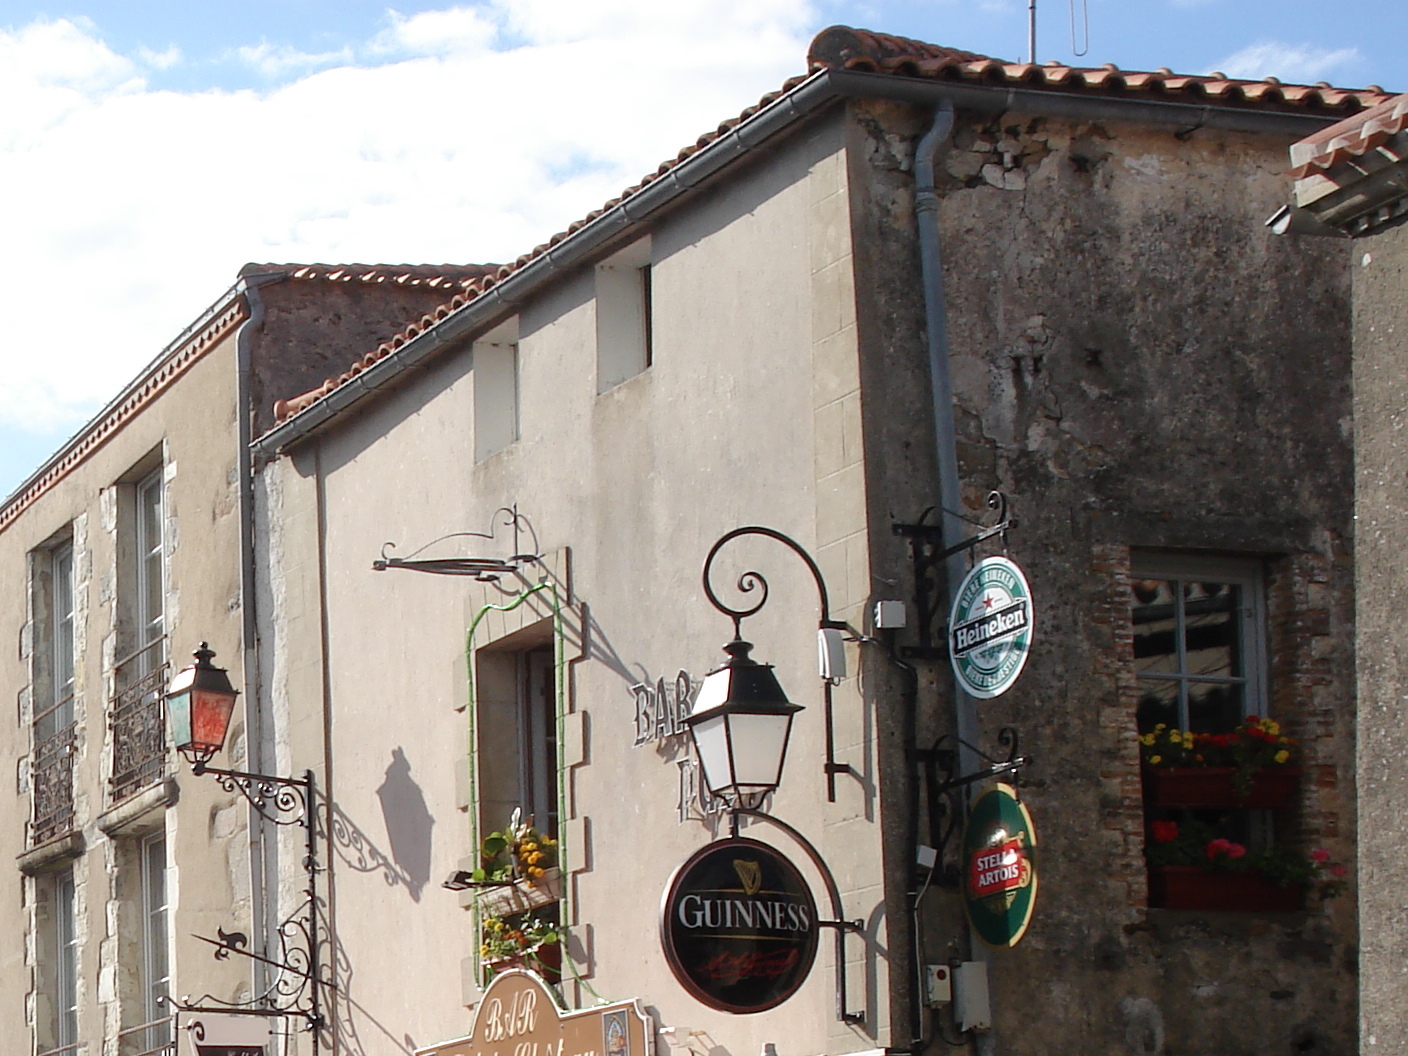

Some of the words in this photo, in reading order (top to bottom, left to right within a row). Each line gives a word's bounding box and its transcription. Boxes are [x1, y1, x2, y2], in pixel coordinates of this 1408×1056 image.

[956, 609, 1025, 650] Heineken
[631, 668, 693, 748] BAR
[978, 864, 1019, 888] ARTOIS
[678, 894, 809, 932] GUINNESS
[484, 988, 539, 1042] BAR
